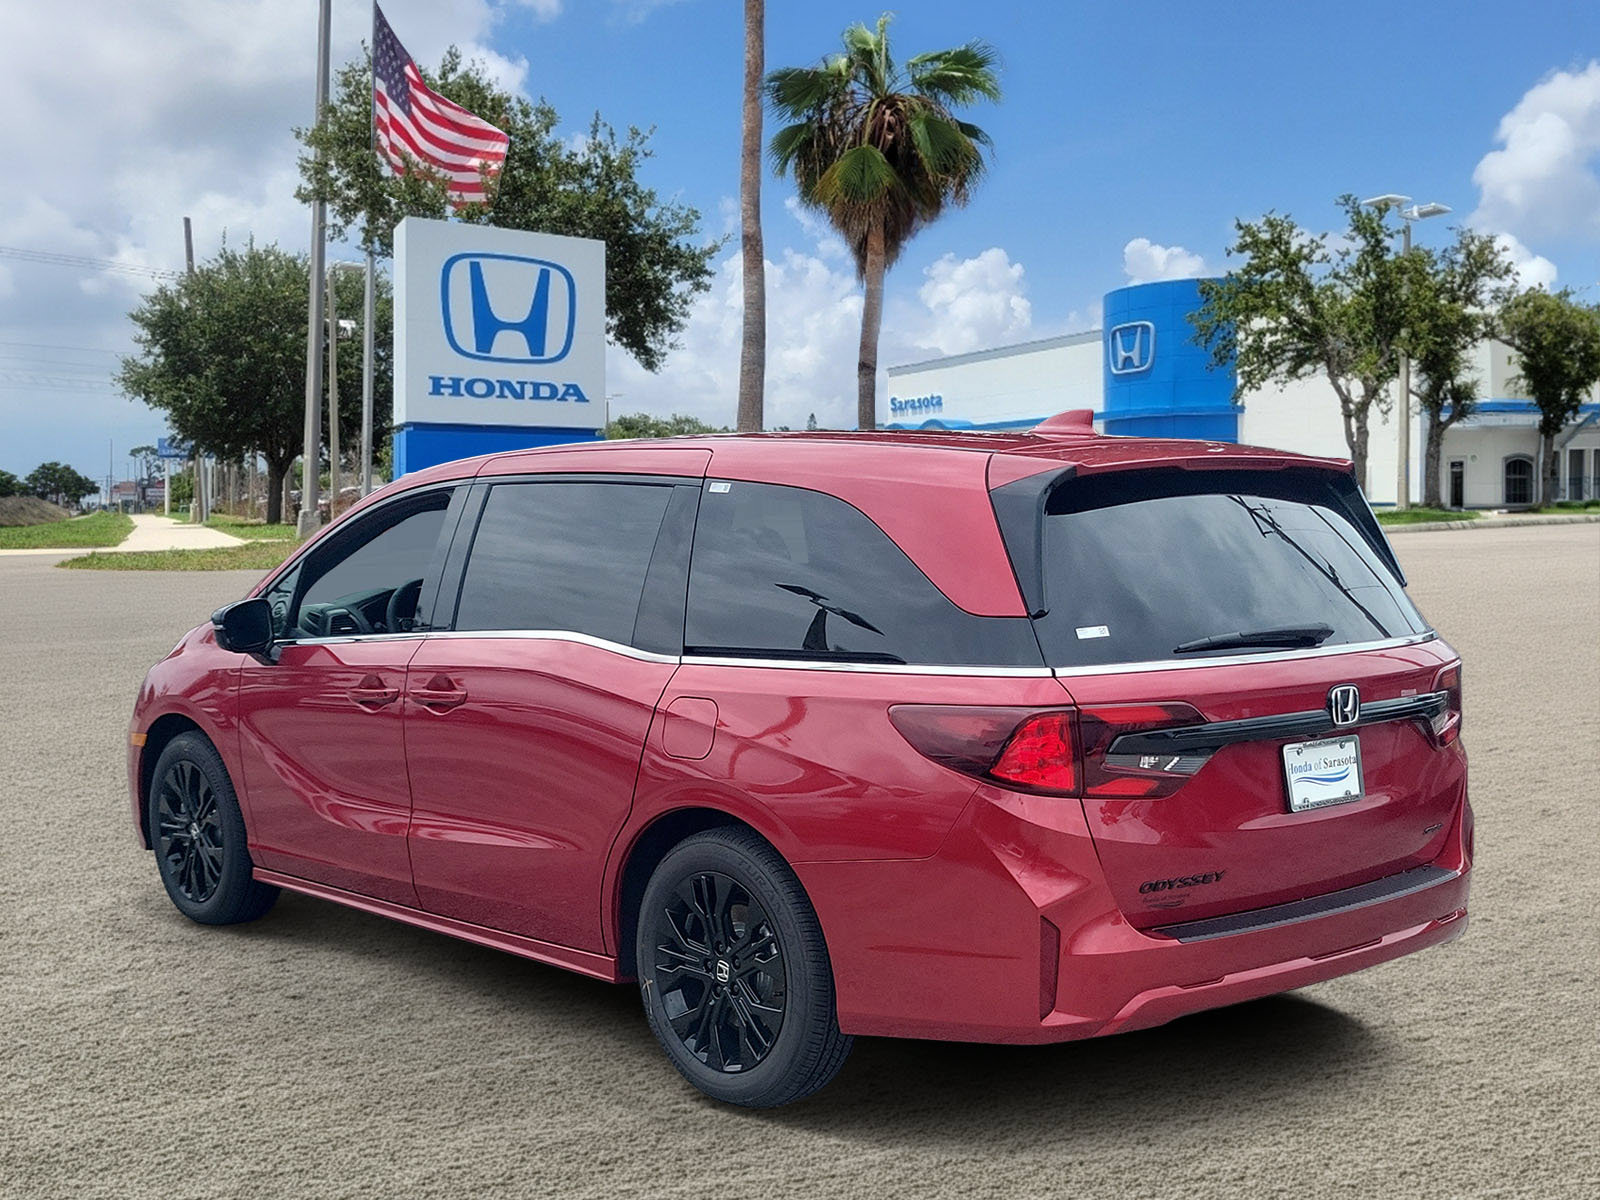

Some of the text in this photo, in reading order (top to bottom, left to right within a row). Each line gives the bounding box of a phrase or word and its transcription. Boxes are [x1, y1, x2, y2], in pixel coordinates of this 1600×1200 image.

[428, 376, 589, 402] HONDA
[890, 394, 943, 412] Sarasota
[1323, 755, 1357, 769] Sarasota
[1139, 869, 1226, 894] ODYSSEY
